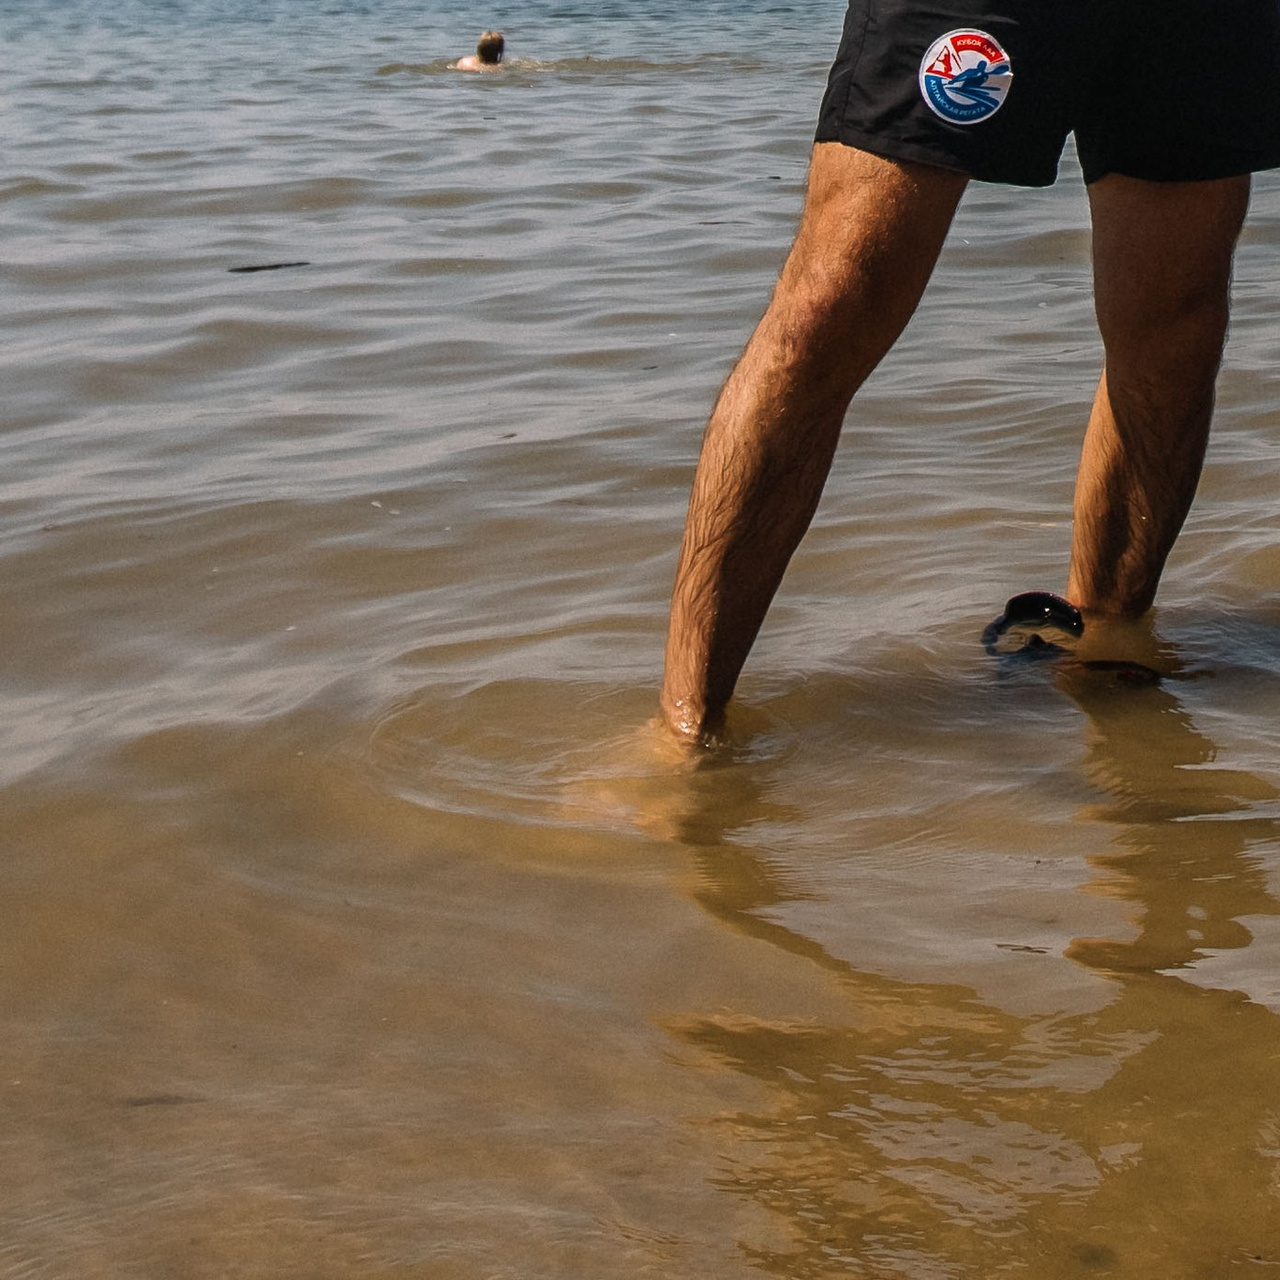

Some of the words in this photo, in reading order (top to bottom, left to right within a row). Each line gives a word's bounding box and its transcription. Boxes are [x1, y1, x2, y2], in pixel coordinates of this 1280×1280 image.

[956, 39, 982, 47] КУБОК
[930, 79, 960, 115] АЛТАЙСКАЯ
[959, 106, 986, 116] РЕГАТА
